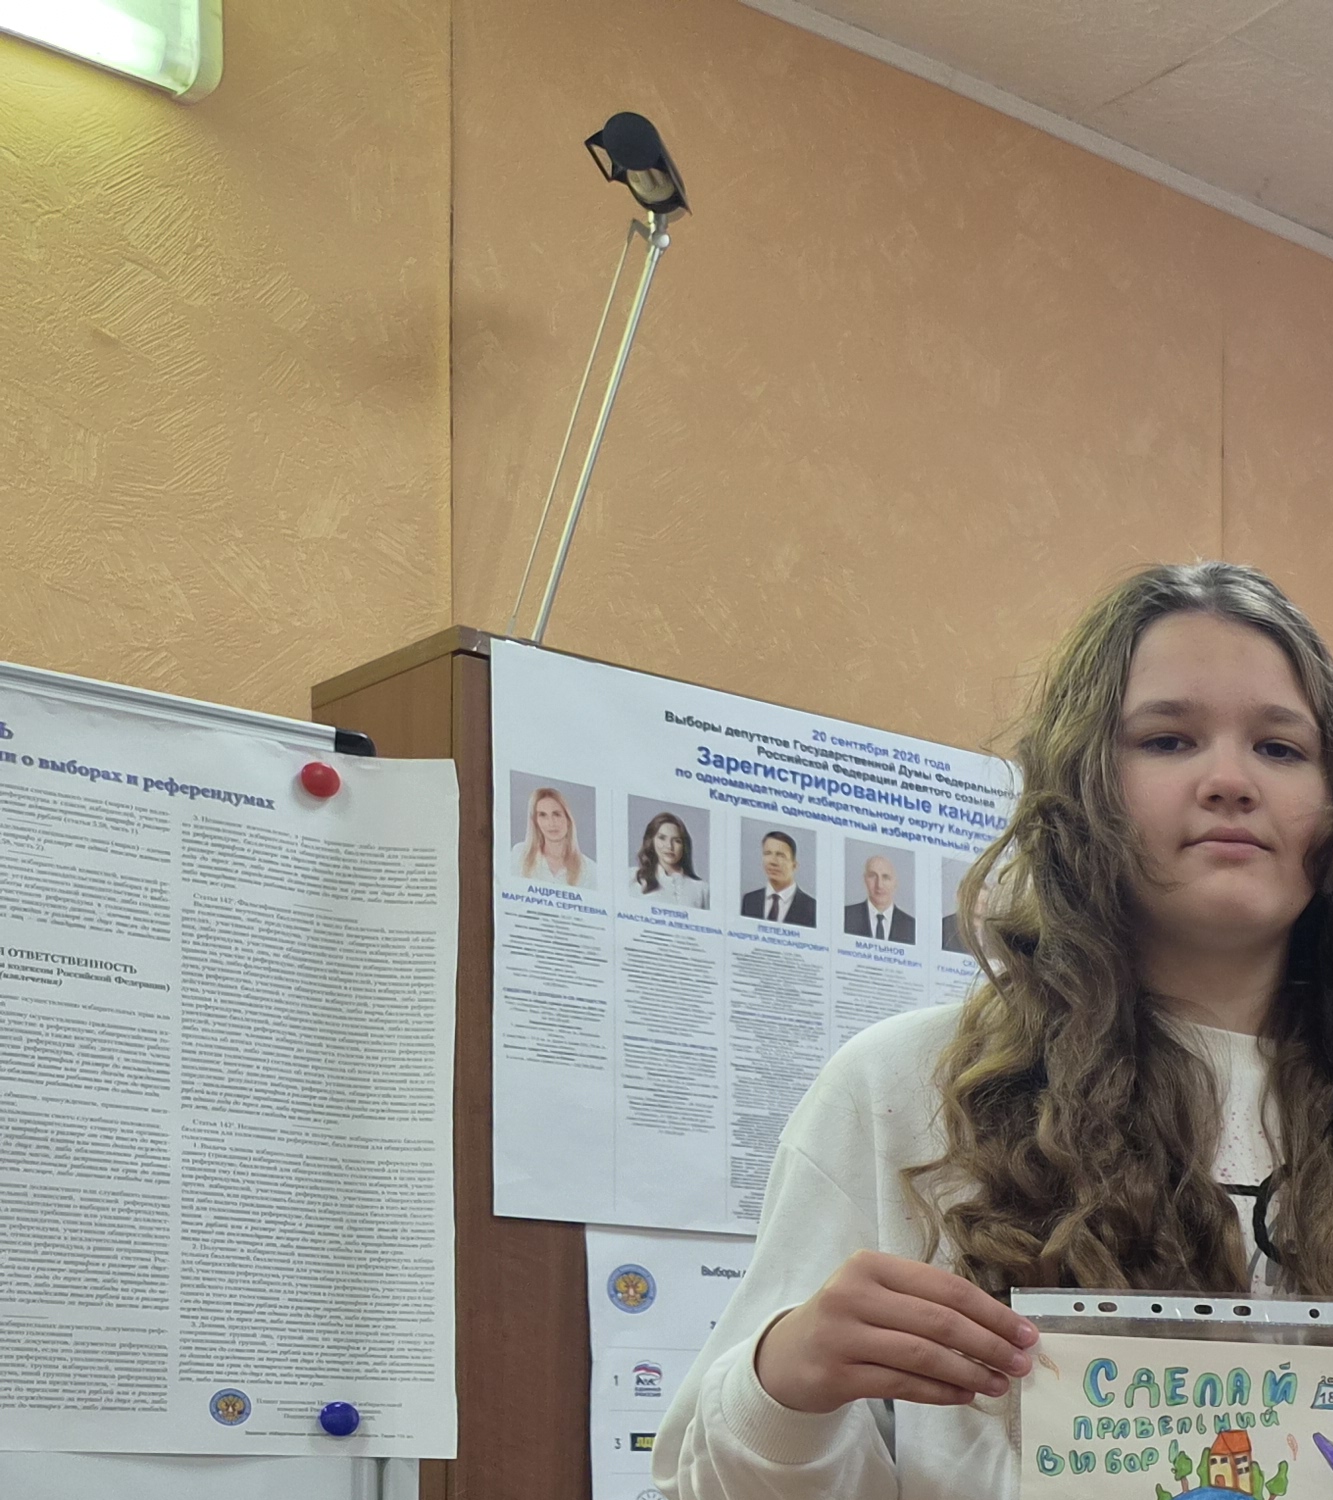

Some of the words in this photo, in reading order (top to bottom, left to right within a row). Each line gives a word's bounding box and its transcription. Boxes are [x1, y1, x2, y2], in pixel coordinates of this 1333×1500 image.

[664, 710, 722, 734] Выборы
[725, 726, 790, 749] депутатов
[794, 740, 896, 773] Государственной
[898, 764, 932, 781] Думы
[812, 729, 827, 743] 20
[831, 735, 889, 757] сентября
[893, 748, 920, 765] 2026
[924, 757, 951, 772] года
[21, 755, 34, 767] о
[38, 757, 123, 783] выборах
[126, 774, 139, 787] и
[143, 777, 275, 810] референдумах
[697, 746, 932, 815] Зарегистрированные
[757, 745, 829, 771] Российской
[833, 763, 898, 787] Федерации
[901, 780, 952, 799] девятого
[955, 792, 996, 809] созыва
[676, 767, 692, 779] по
[696, 773, 804, 804] одномандатному
[808, 796, 905, 826] избирательному
[908, 817, 944, 833] округу
[709, 788, 778, 812] Калужский
[781, 804, 878, 832] одномандатный
[881, 825, 971, 852] избирательный
[501, 891, 554, 908] МАРГАРИТА
[556, 901, 608, 917] СЕРГЕЕВНА
[527, 884, 583, 902] АНДРЕЕВА
[616, 911, 667, 927] АНАСТАСИЯ
[8, 948, 137, 975] ОТВЕТСТВЕННОСТЬ
[855, 940, 905, 956] МАРТЫНОВ
[56, 967, 112, 983] Российской
[114, 975, 171, 992] Федерации)
[701, 1265, 740, 1280] Выборы
[613, 1375, 619, 1386] 1
[1083, 1357, 1298, 1408] СДЕЛАЙ
[614, 1438, 622, 1450] 3
